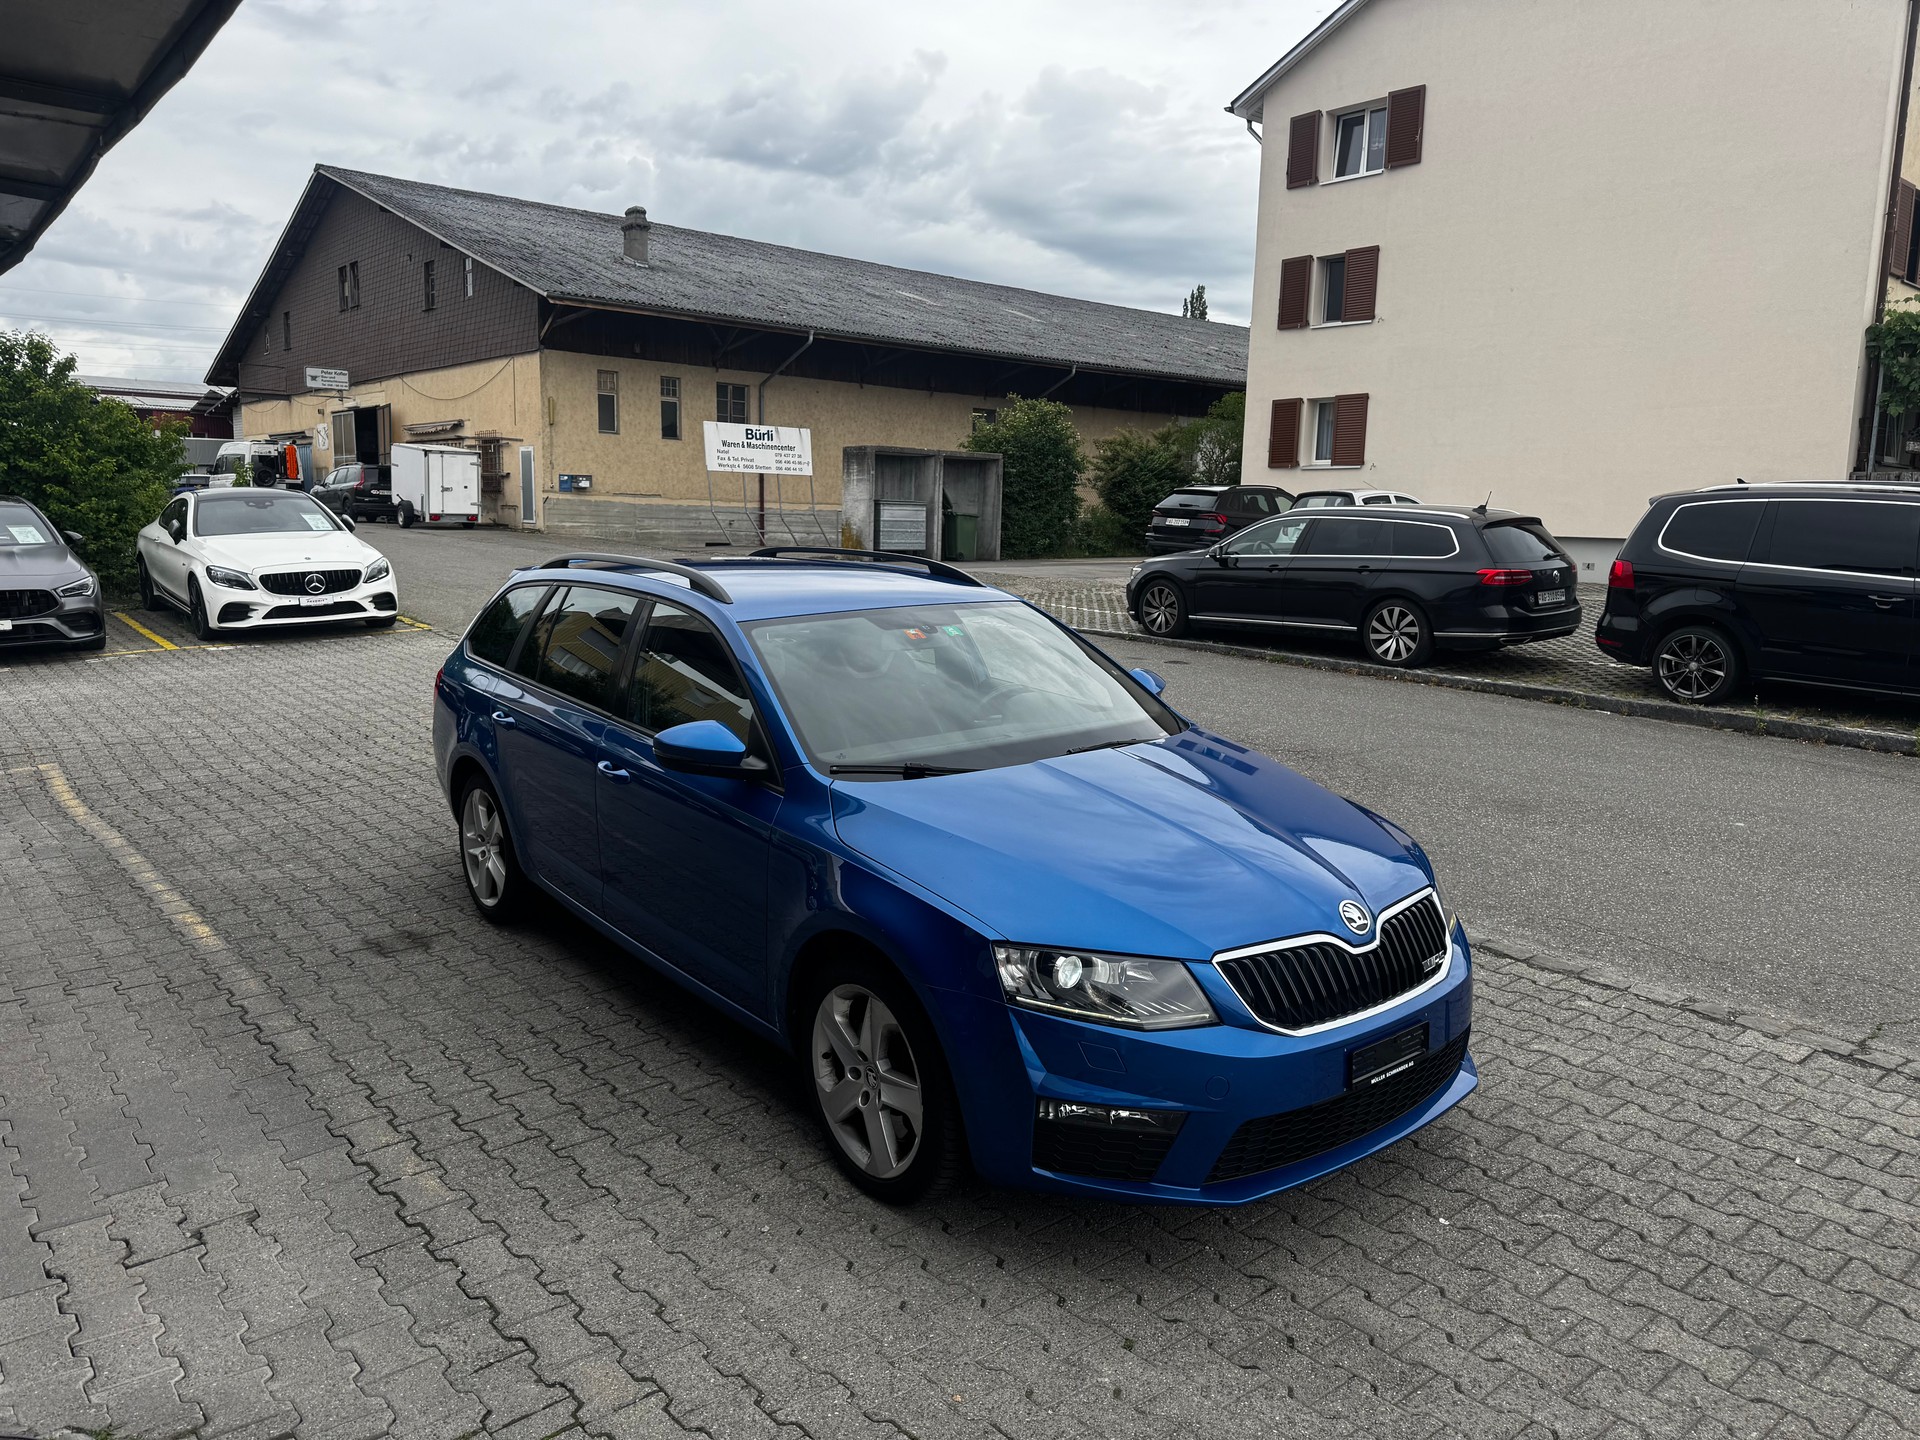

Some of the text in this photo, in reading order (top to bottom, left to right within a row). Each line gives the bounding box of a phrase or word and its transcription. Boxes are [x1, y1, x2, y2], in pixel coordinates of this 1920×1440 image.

[745, 428, 774, 442] Bürli
[721, 440, 740, 448] Waren
[746, 442, 796, 451] Maschinencenter
[1371, 1074, 1385, 1084] MÜLLER
